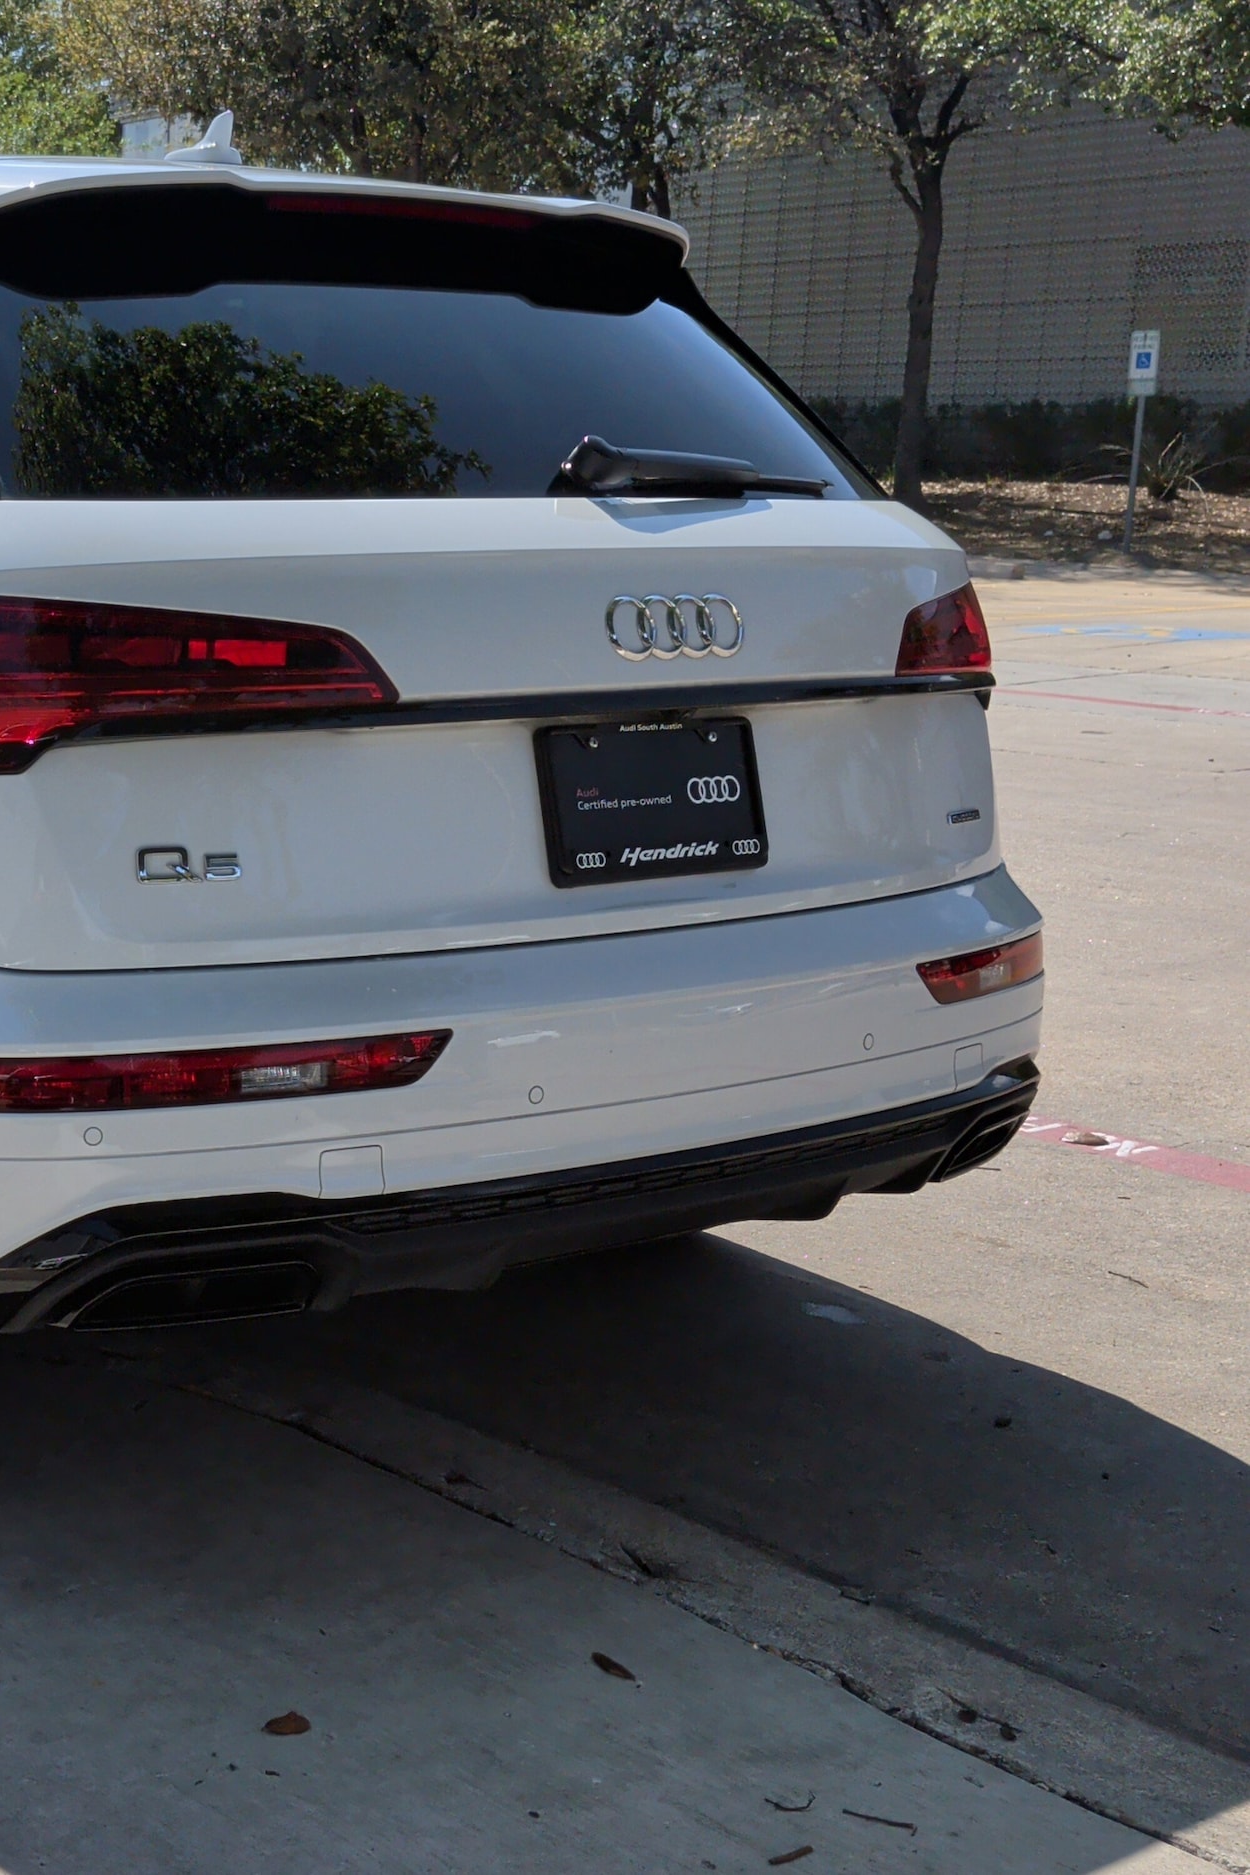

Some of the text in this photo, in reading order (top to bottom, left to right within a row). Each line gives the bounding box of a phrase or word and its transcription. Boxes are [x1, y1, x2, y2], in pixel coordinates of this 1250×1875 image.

[637, 723, 658, 731] South
[577, 788, 599, 797] Audi
[577, 795, 672, 810] Certified pre-owned
[620, 841, 719, 866] Hendrick
[136, 847, 242, 884] Q5
